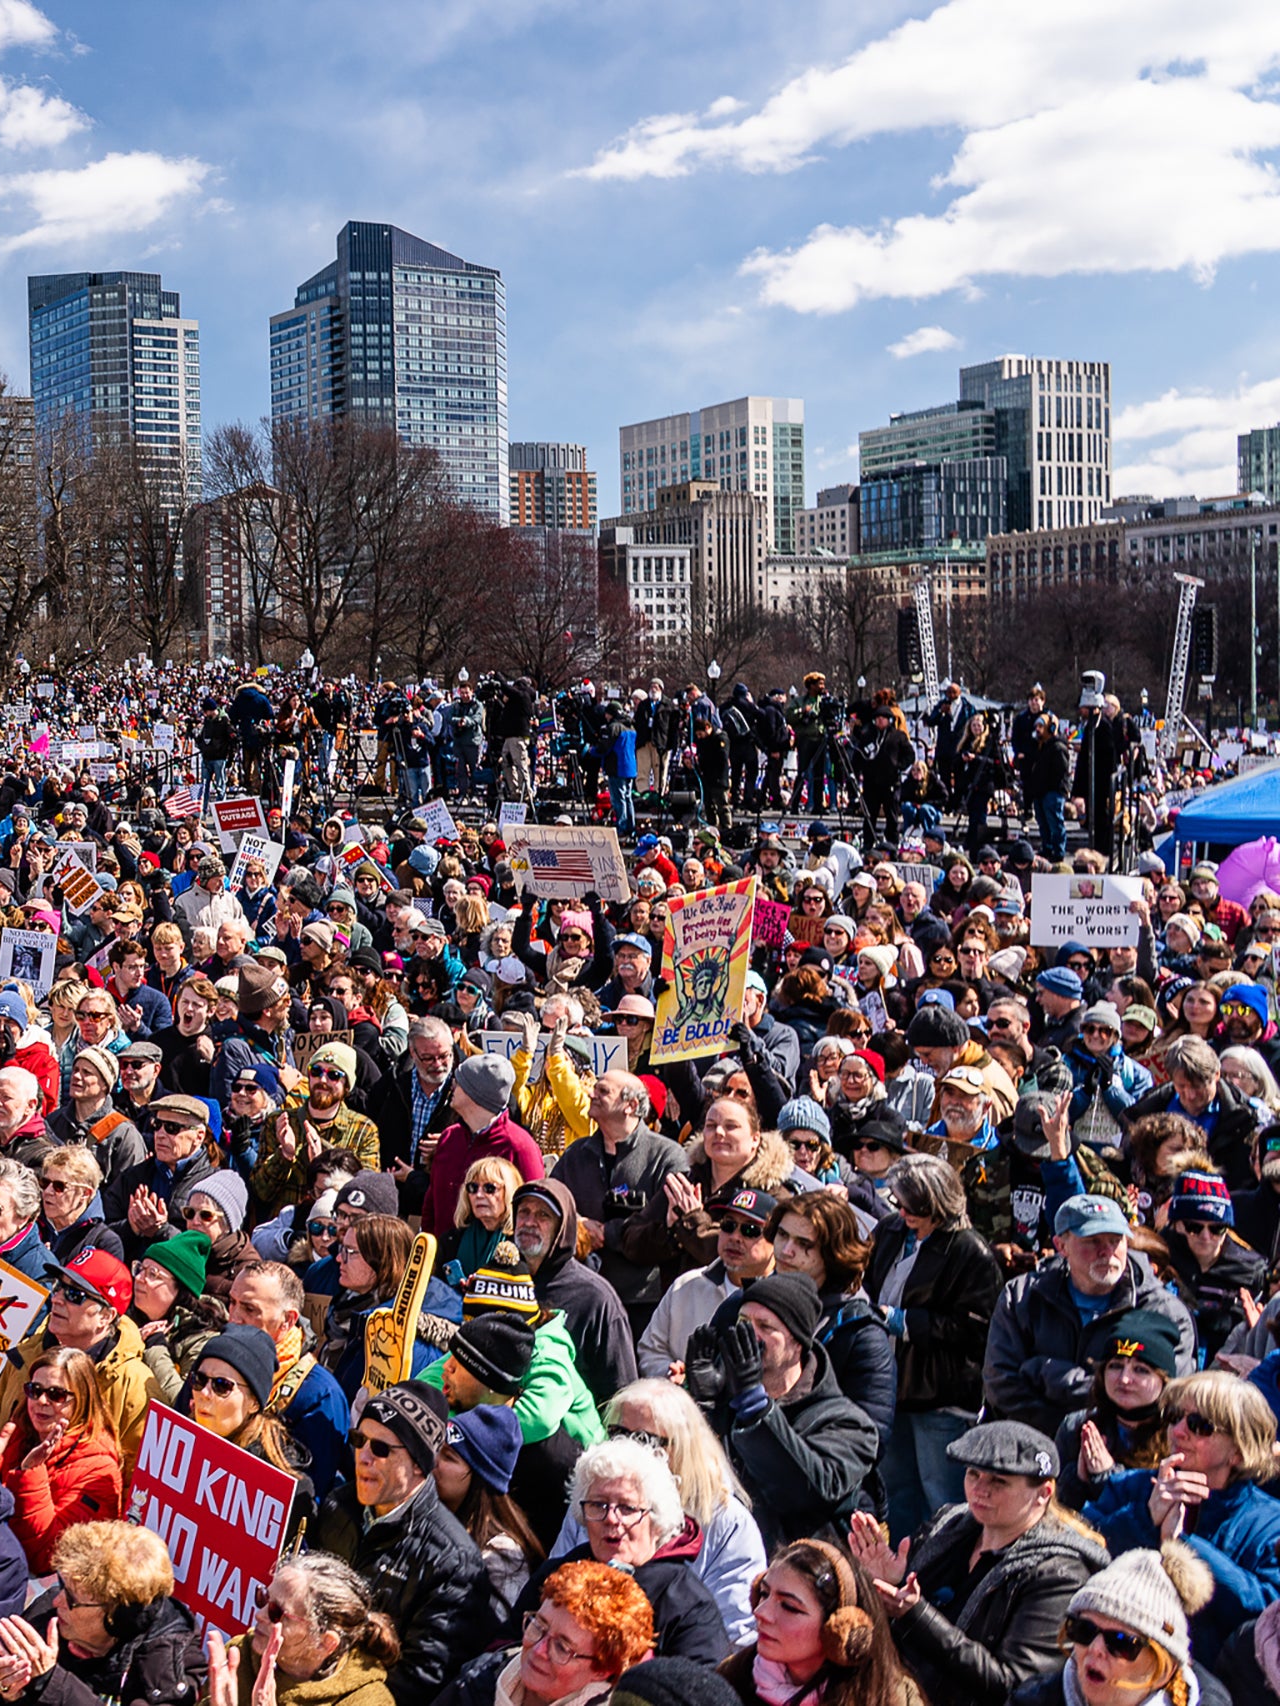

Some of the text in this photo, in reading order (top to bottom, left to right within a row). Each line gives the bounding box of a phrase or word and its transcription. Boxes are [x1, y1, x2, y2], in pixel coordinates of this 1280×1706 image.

[220, 811, 257, 822] OUTRAGE
[245, 837, 267, 850] NOT
[513, 827, 607, 849] REJECTING
[242, 845, 263, 857] LEFT
[589, 855, 625, 873] KINGS
[525, 880, 559, 894] SINCE
[682, 908, 697, 920] We
[1051, 905, 1129, 915] THE WORST
[682, 916, 731, 934] Freedom lies
[1075, 915, 1092, 925] OF
[21, 931, 39, 940] SIGN
[694, 929, 717, 942] being
[1051, 925, 1129, 936] THE WORST
[3, 936, 54, 949] BIG ENOUGH
[662, 1019, 730, 1046] BE BOLD!
[486, 1037, 620, 1077] EMPHY
[1010, 1190, 1047, 1211] EED
[411, 1244, 424, 1264] GO
[396, 1269, 419, 1327] BRUINS
[474, 1279, 536, 1301] BRUINS
[137, 1409, 285, 1550] NO KING
[144, 1495, 269, 1627] NO WAR
